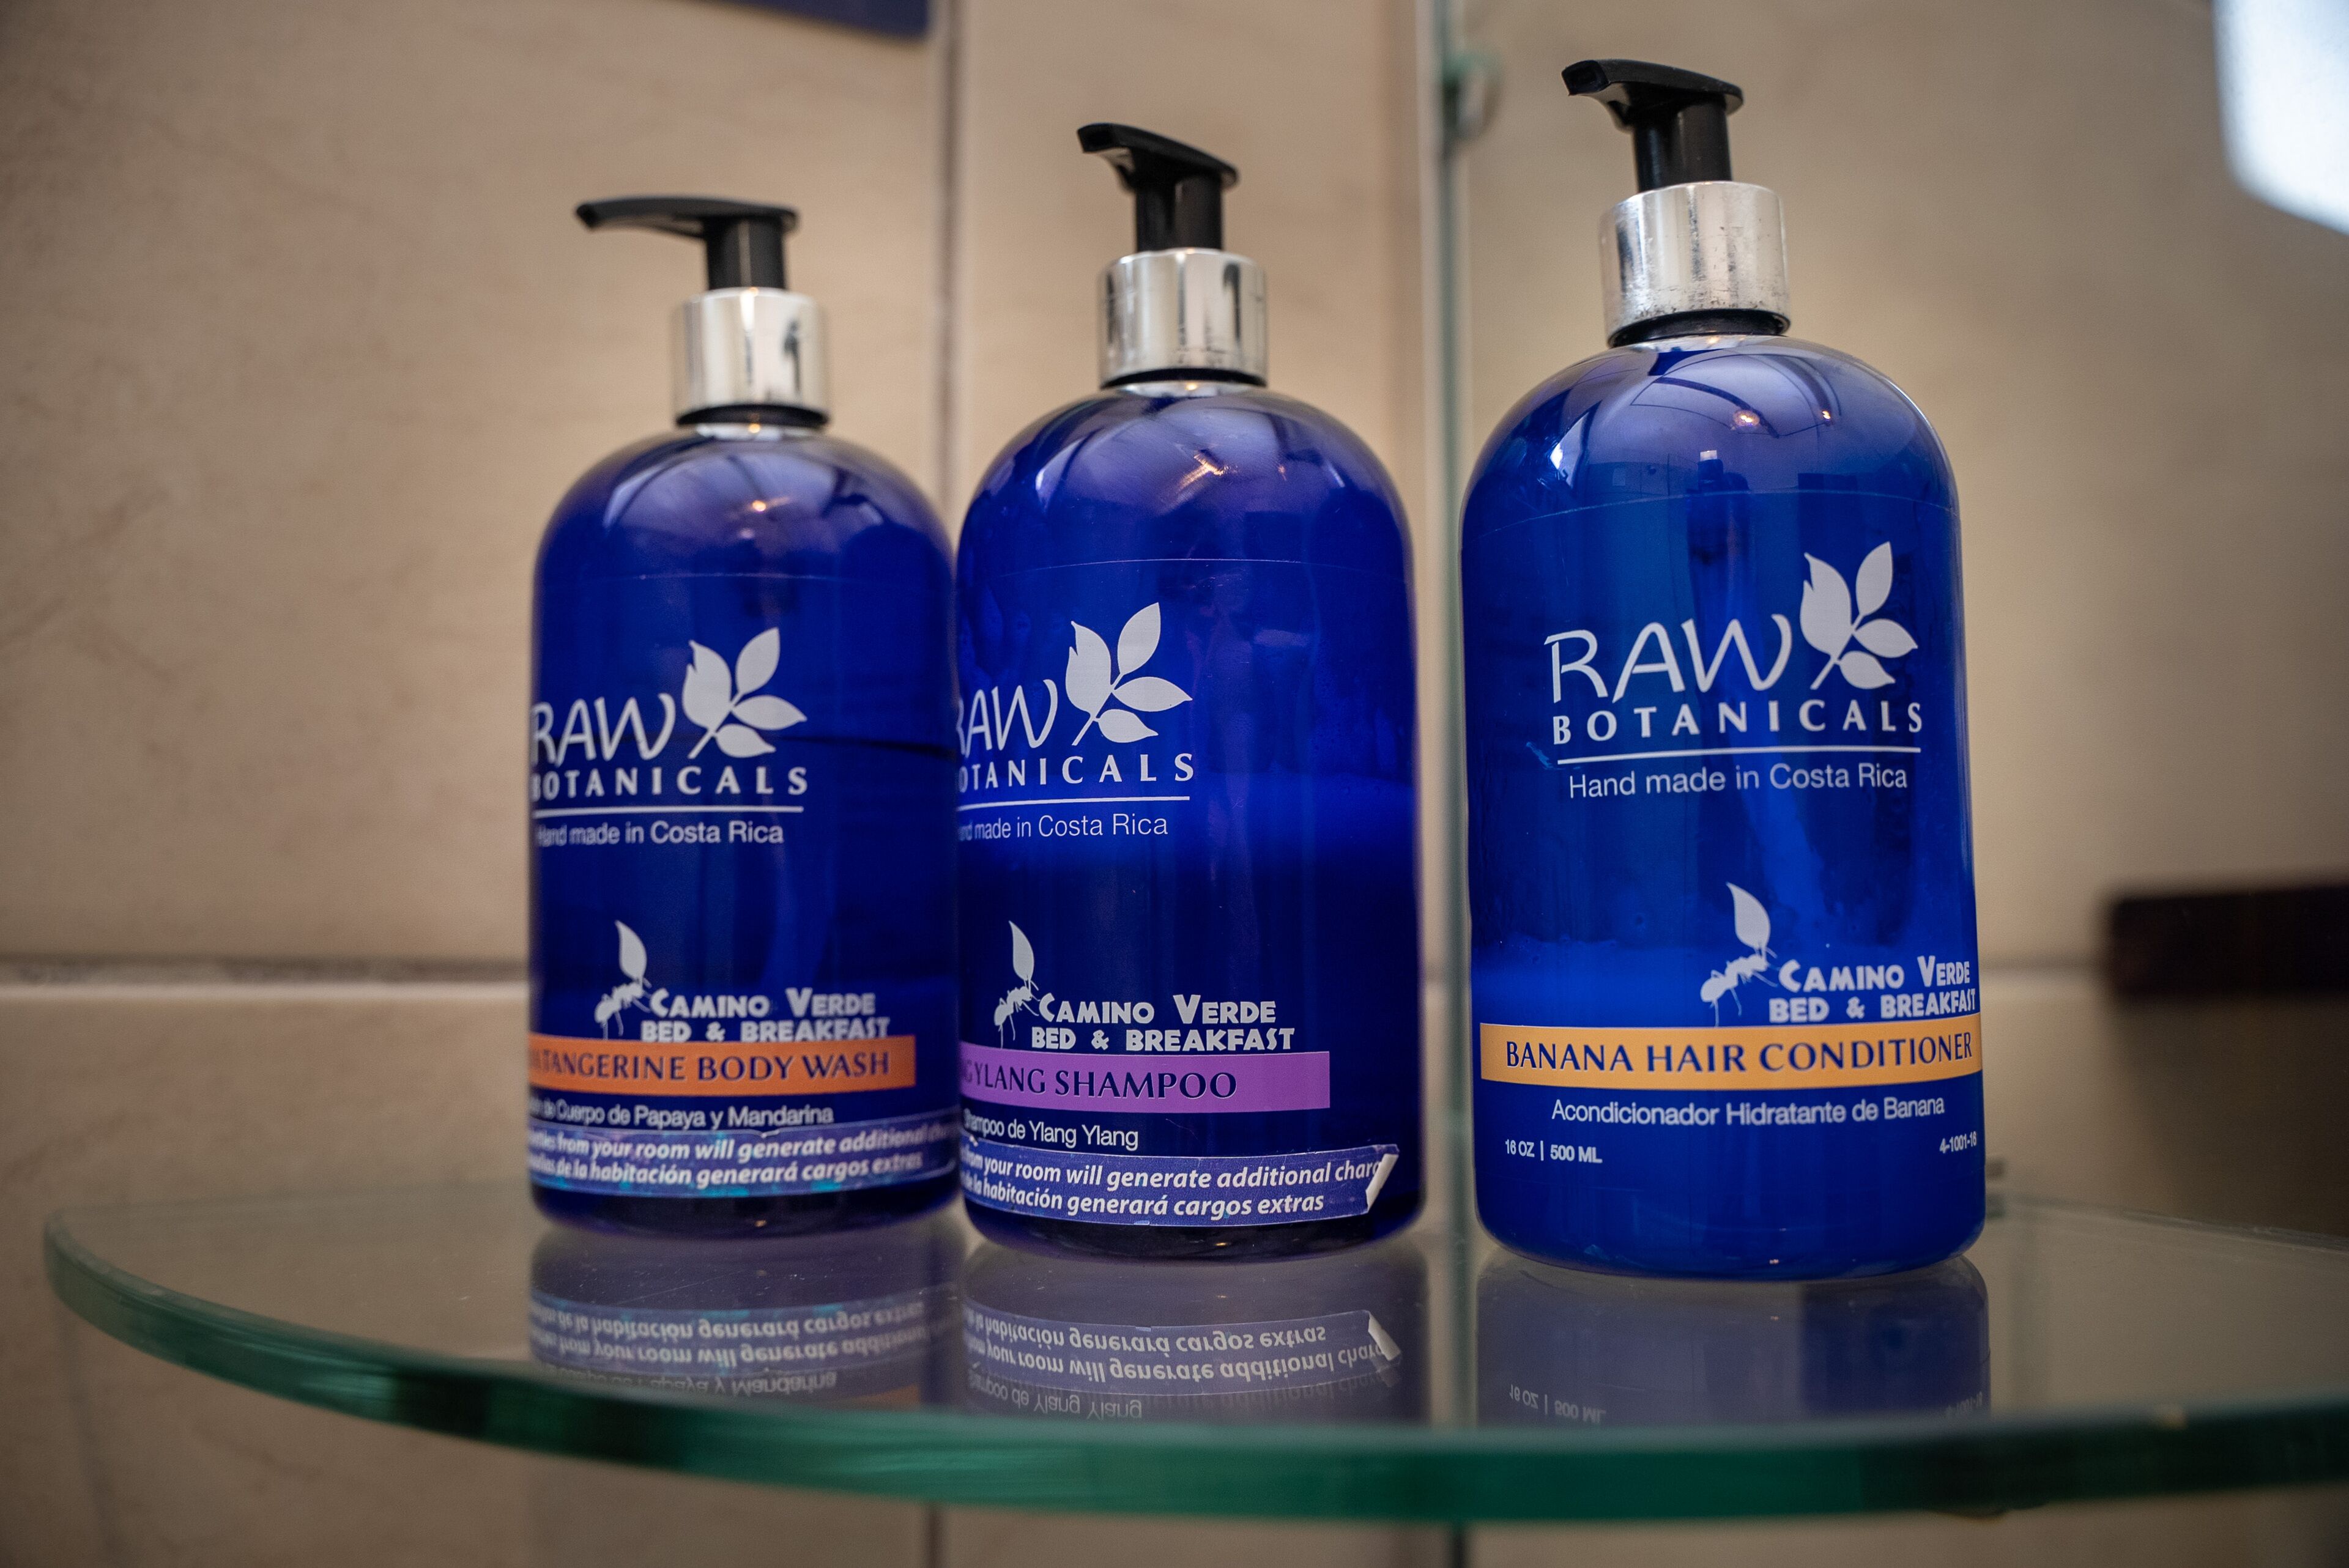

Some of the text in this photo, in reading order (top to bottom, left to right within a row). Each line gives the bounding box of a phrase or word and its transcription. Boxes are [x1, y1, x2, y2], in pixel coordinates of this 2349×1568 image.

[1543, 613, 1792, 703] RAW
[531, 693, 676, 767] RAW
[1553, 699, 1923, 745] BOTANICALS
[959, 753, 1194, 793] OTANICALS
[1569, 761, 1909, 799] Hand made in Costa Rica
[569, 821, 620, 845] made
[626, 821, 644, 844] in
[650, 819, 721, 843] Costa
[729, 819, 784, 843] Rica
[977, 818, 1011, 839] made
[1017, 816, 1031, 837] in
[1038, 815, 1104, 836] Costa
[1112, 813, 1169, 835] Rica
[1778, 955, 1970, 993] CAMINO VERDE
[650, 987, 876, 1019] CAMINO VERDE
[1038, 992, 1277, 1024] CAMINO VERDE
[1768, 988, 1976, 1023] BED & BREAKFAST
[640, 1016, 891, 1042] BED & BREAKFAST
[1031, 1027, 1296, 1052] BED & BREAKFAST
[543, 1049, 686, 1081] TANGERINE
[697, 1055, 795, 1082] BODY
[802, 1051, 891, 1079] WASH
[1506, 1031, 1973, 1073] BANANA HAIR CONDITIONER
[974, 1061, 1046, 1095] YLANG
[1055, 1070, 1238, 1100] SHAMPOO
[556, 1098, 605, 1126] Cuerpo
[607, 1103, 631, 1126] de
[633, 1104, 707, 1130] Papaya
[710, 1109, 724, 1130] y
[728, 1104, 834, 1127] Mandarina
[1551, 1096, 1945, 1126] Acondicionador Hidratante de Banana
[557, 1131, 589, 1155] from
[592, 1141, 634, 1161] your
[634, 1142, 691, 1159] room
[695, 1139, 733, 1160] will
[738, 1137, 836, 1164] generate
[839, 1125, 927, 1153] additional
[1008, 1119, 1026, 1140] de
[1028, 1120, 1077, 1148] Ylang
[1081, 1123, 1139, 1152] Ylang
[1505, 1139, 1516, 1155] 16
[1518, 1141, 1535, 1157] OZ
[1550, 1144, 1575, 1161] 500
[1578, 1145, 1603, 1163] ML
[1939, 1130, 1978, 1154] 4-1001-16
[572, 1158, 588, 1179] la
[588, 1159, 692, 1184] habitación
[696, 1161, 798, 1189] generará
[801, 1159, 869, 1183] cargos
[872, 1152, 924, 1173] extras
[983, 1155, 1013, 1177] your
[1015, 1161, 1061, 1183] room
[1066, 1164, 1104, 1186] will
[1107, 1169, 1211, 1192] generate
[1217, 1162, 1332, 1188] additional
[982, 1177, 1063, 1210] habitación
[1067, 1195, 1168, 1216] generará
[1173, 1198, 1252, 1221] cargos
[1257, 1194, 1324, 1215] extras
